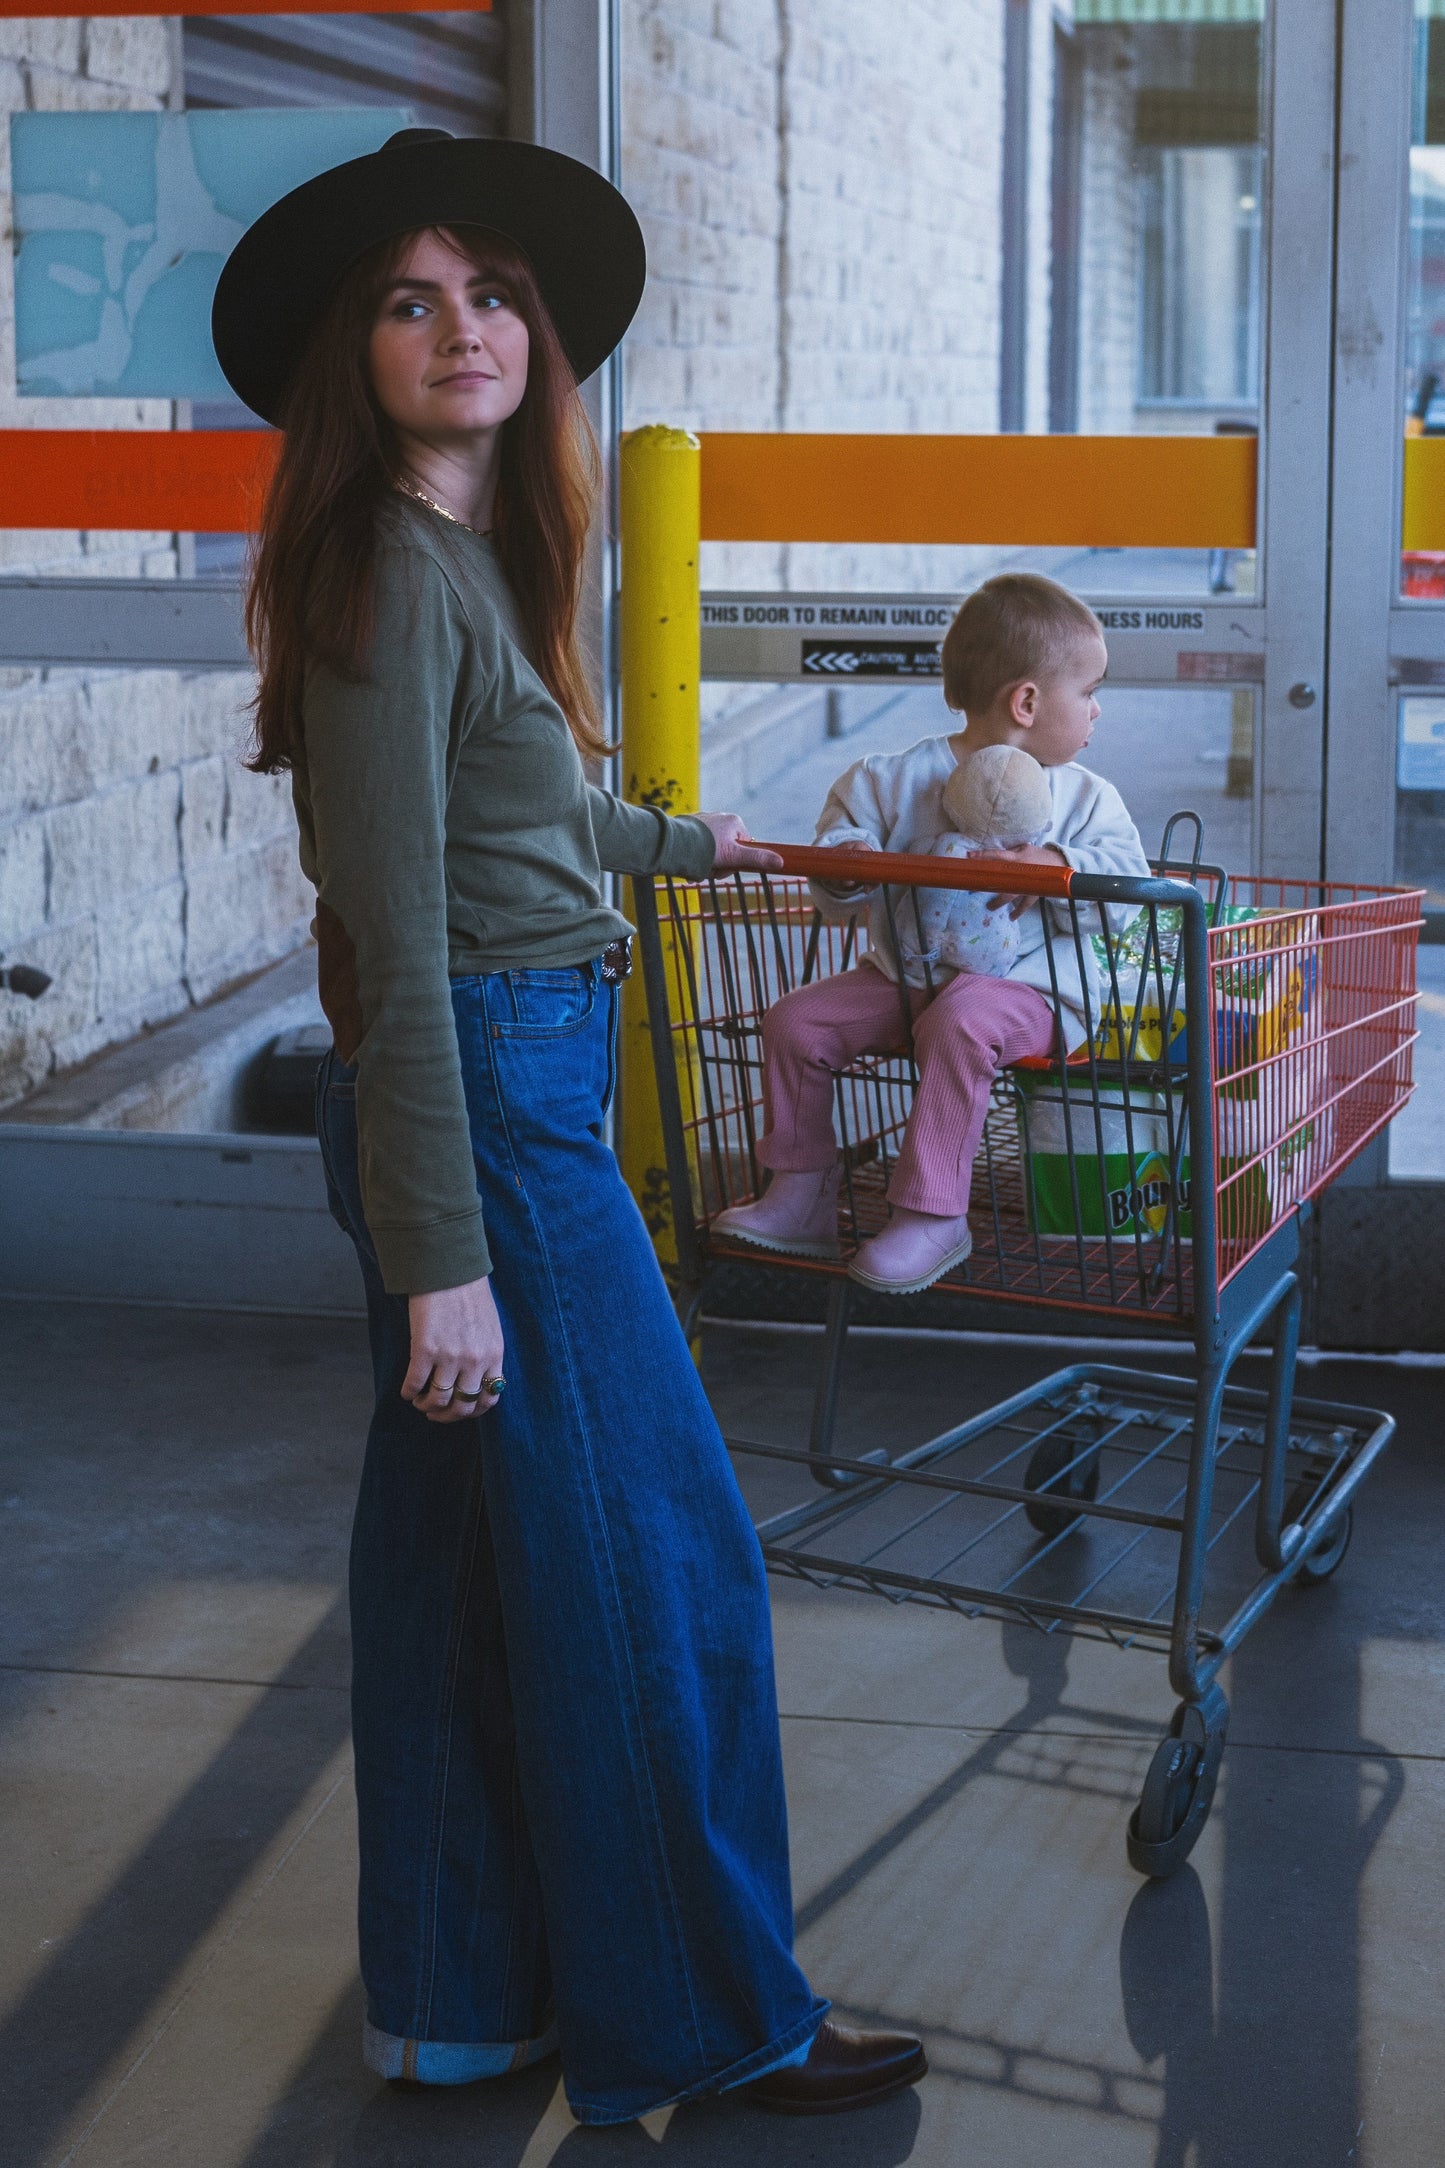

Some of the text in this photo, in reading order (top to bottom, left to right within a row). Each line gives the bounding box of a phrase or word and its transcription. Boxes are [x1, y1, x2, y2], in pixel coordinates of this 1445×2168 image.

[702, 606, 1203, 629] THIS DOOR TO REMAIN UNLOC NESS HOURS
